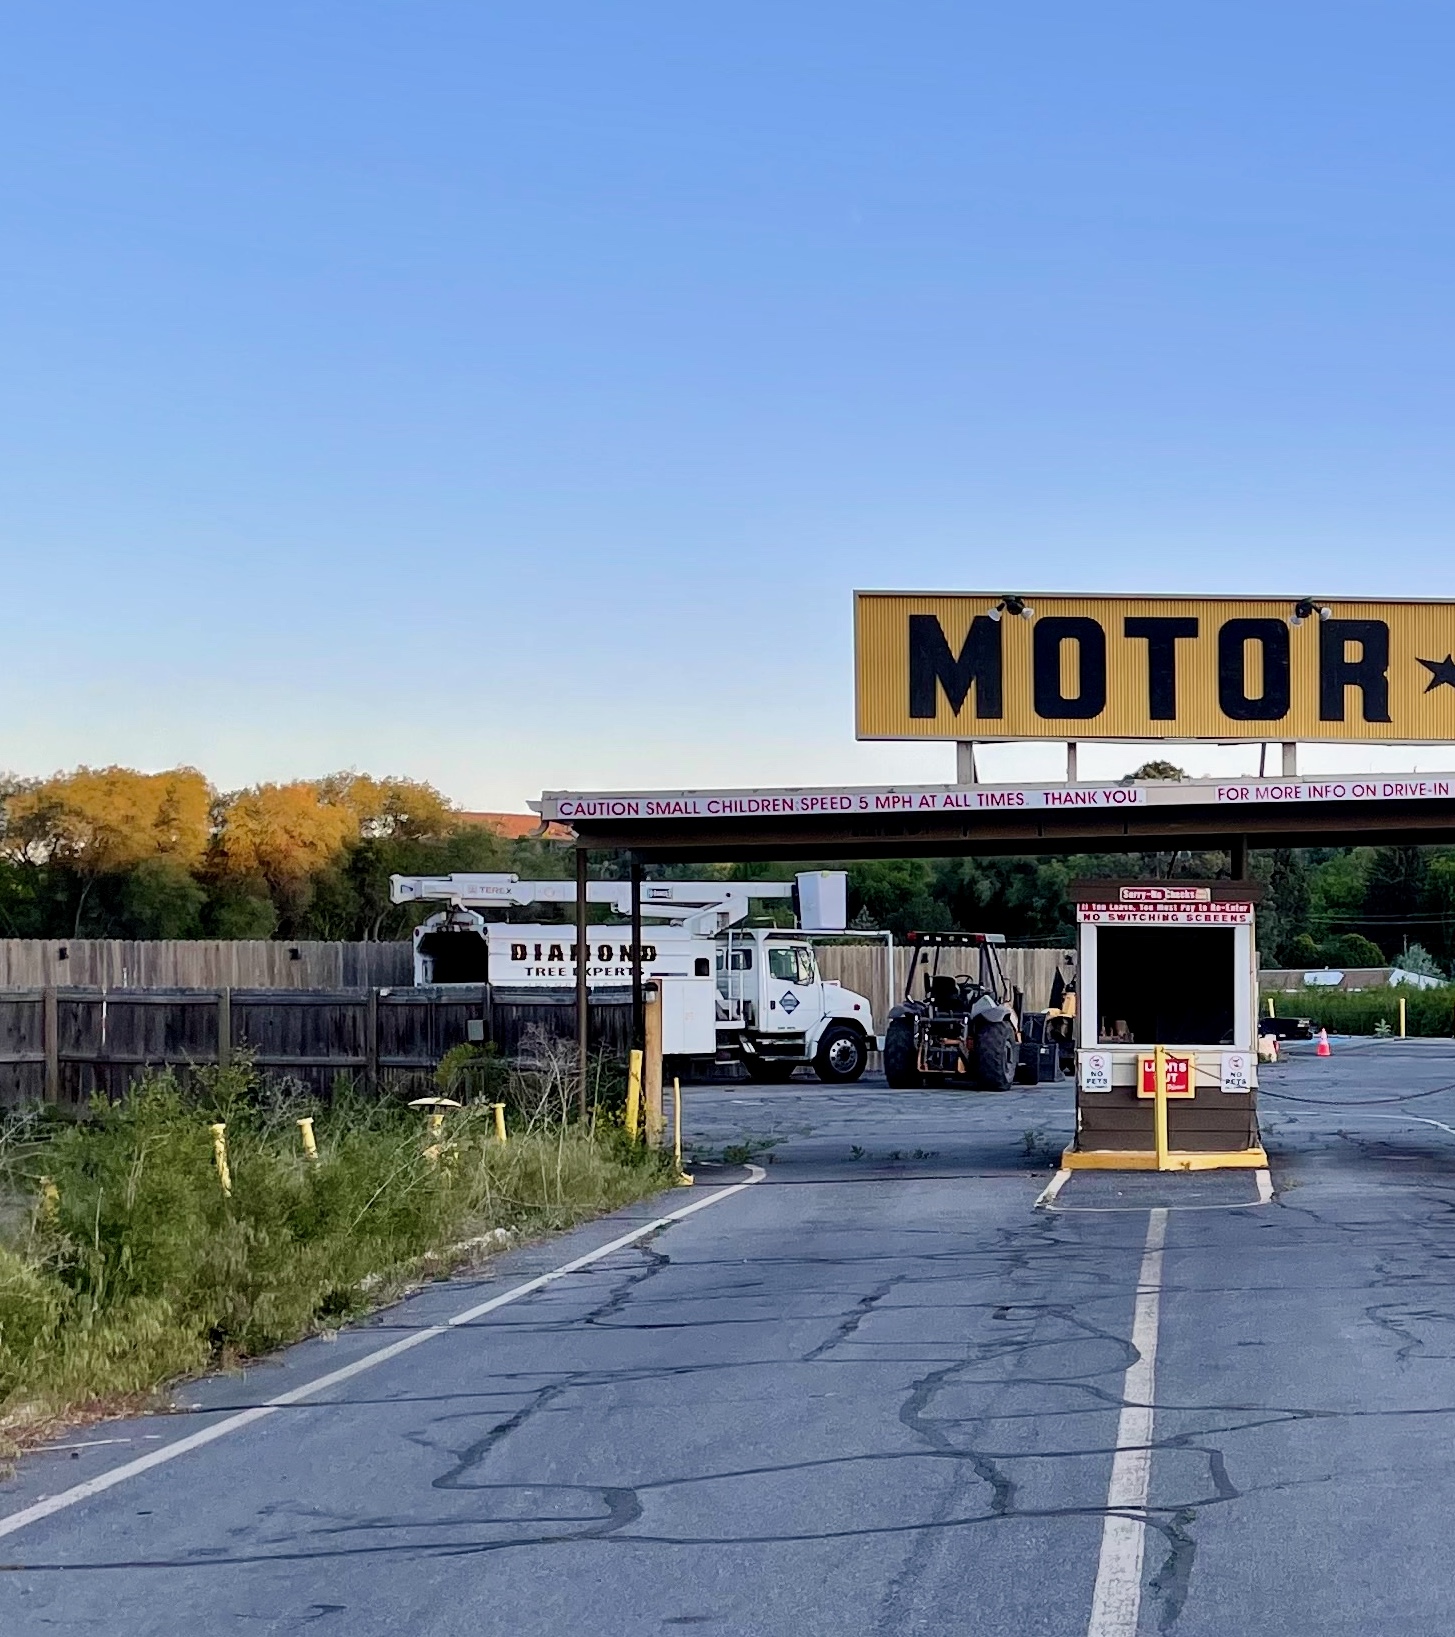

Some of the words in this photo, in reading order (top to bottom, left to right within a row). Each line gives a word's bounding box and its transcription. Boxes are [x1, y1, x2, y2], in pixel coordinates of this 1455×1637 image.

[909, 615, 1392, 722] MOTOR
[1043, 790, 1098, 805] THANK
[1217, 786, 1250, 801] FOR
[1255, 785, 1302, 800] MORE
[1308, 784, 1346, 799] INFO
[1352, 783, 1377, 797] ON
[1383, 782, 1449, 797] DRIVE-IN
[559, 801, 639, 816] CAUTION
[645, 801, 700, 815] SMALL
[707, 798, 794, 814] CHILDREN
[800, 796, 852, 811] SPEED
[859, 796, 869, 810] 5
[875, 795, 912, 809] MPH
[918, 794, 937, 809] AT
[943, 793, 971, 808] ALL
[1083, 913, 1100, 921] NO
[1108, 913, 1179, 922] SWITCHING
[525, 966, 567, 976] TREE
